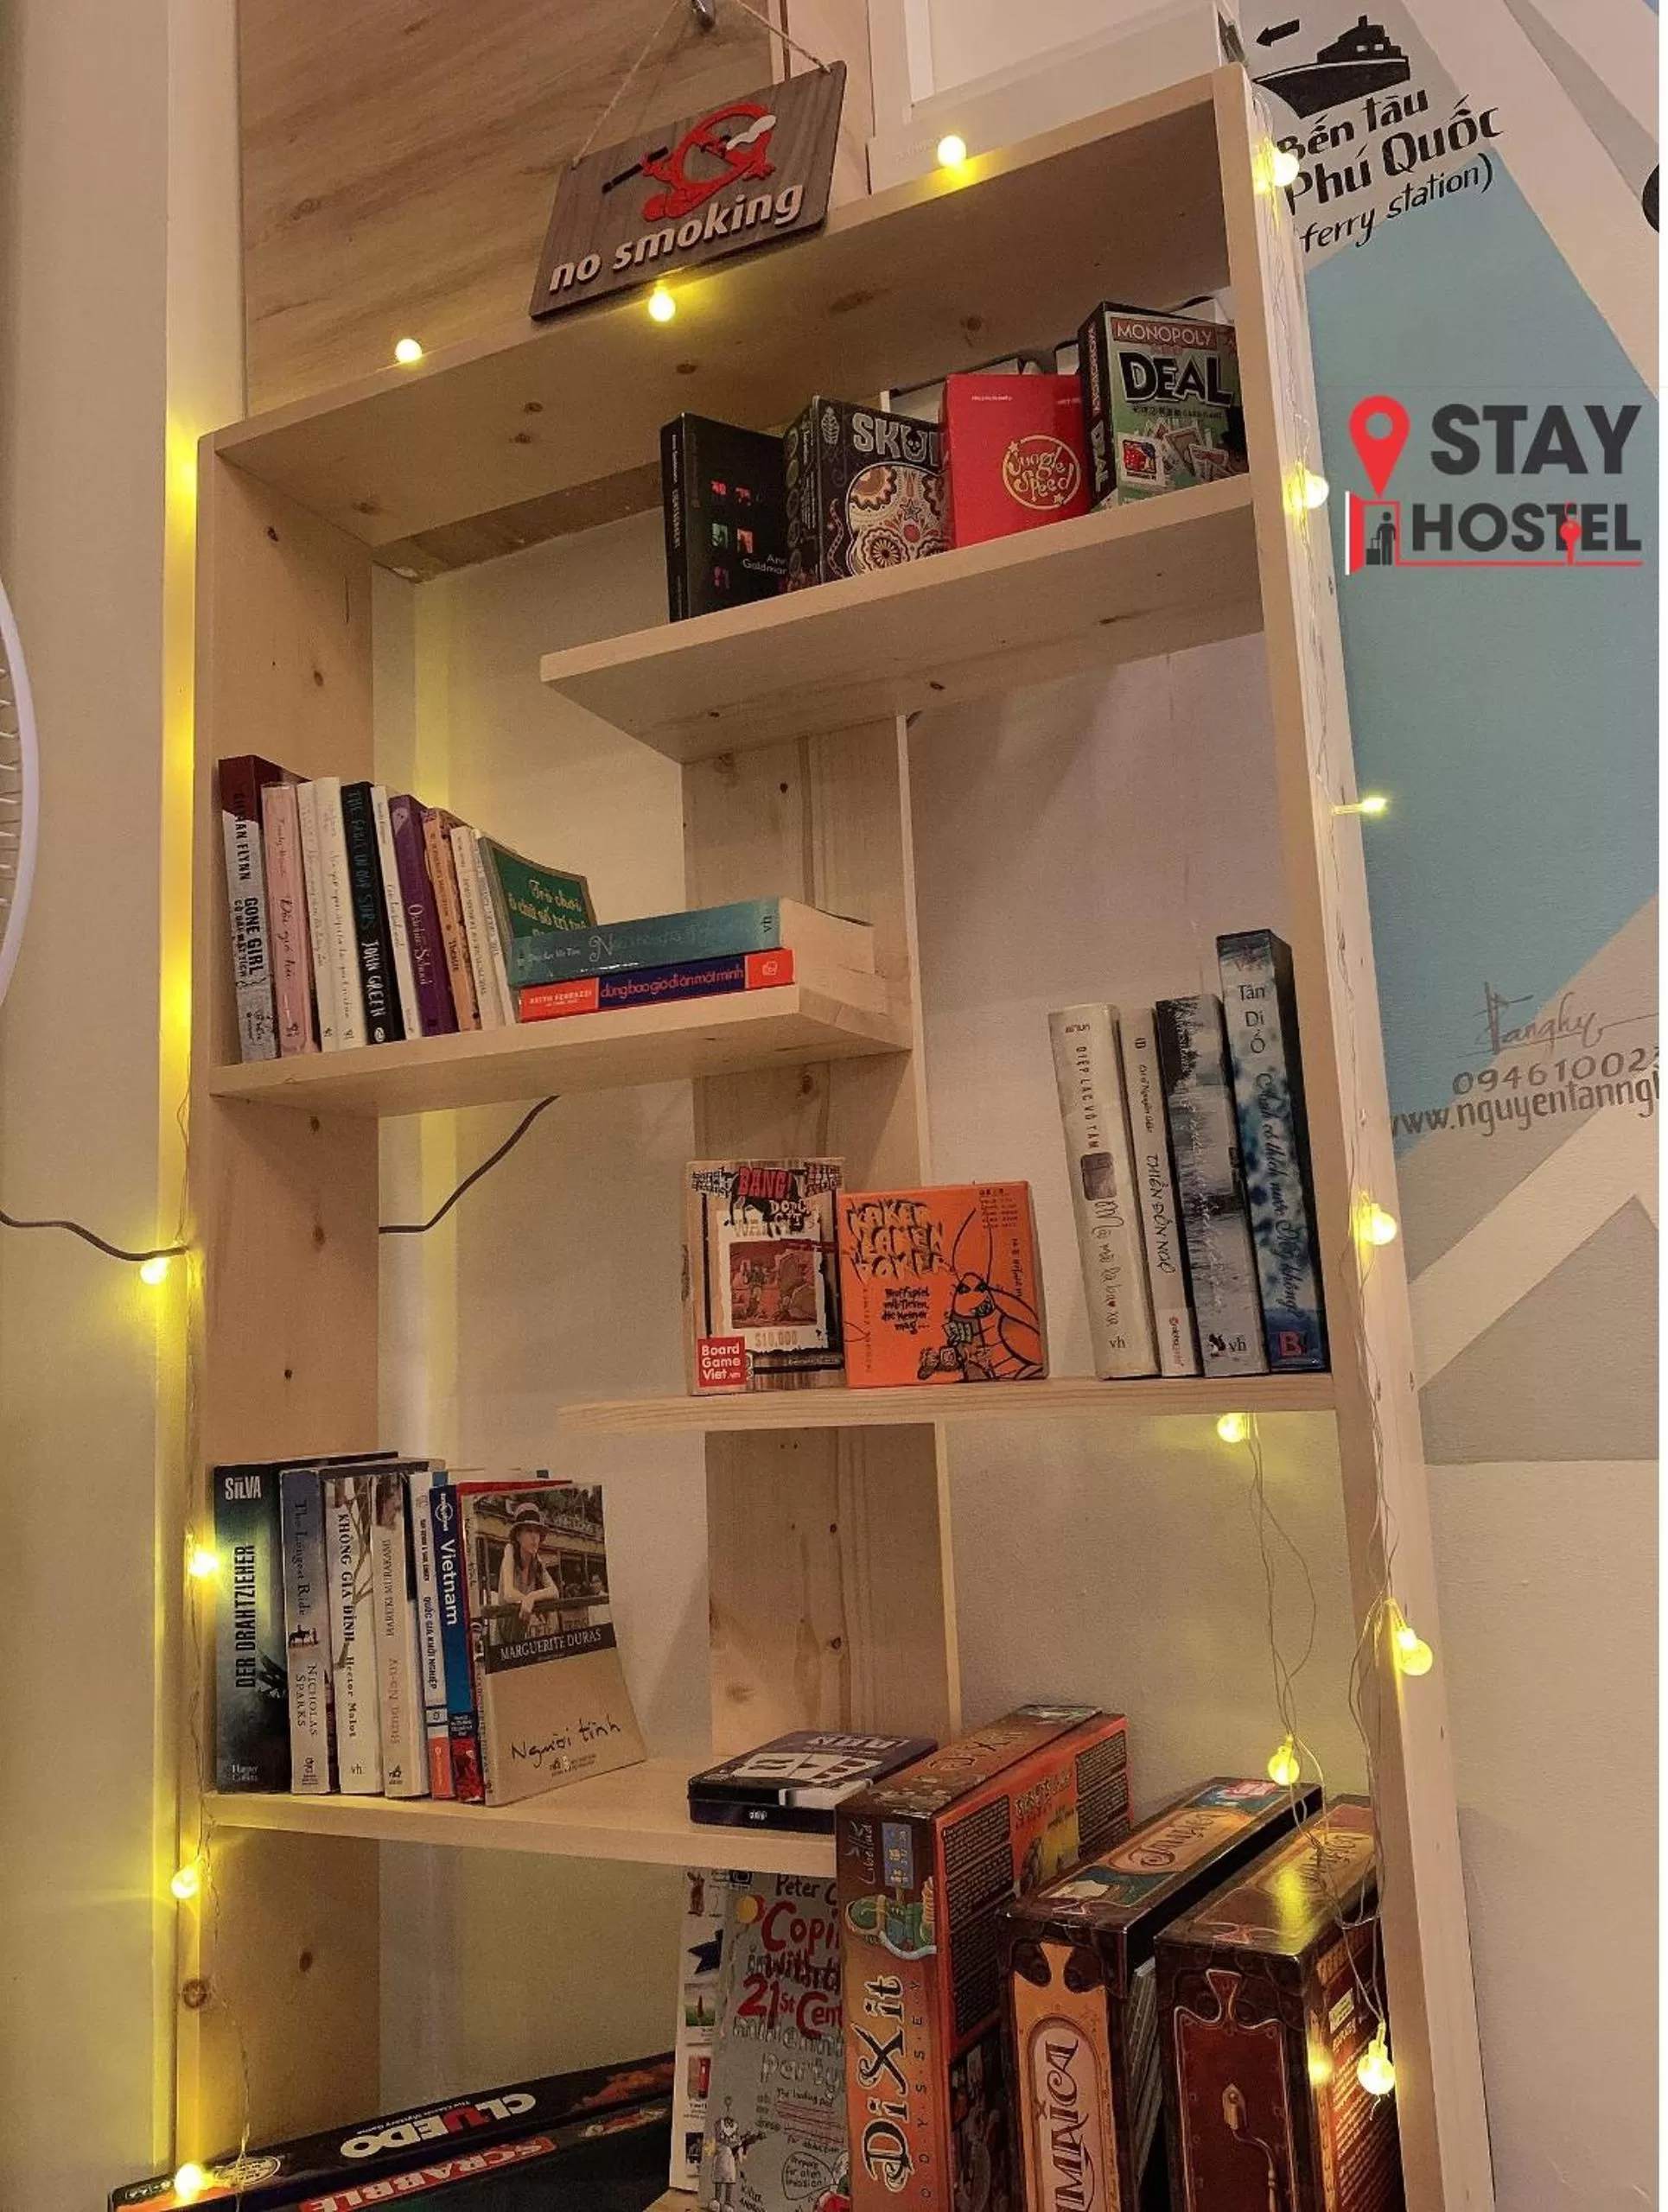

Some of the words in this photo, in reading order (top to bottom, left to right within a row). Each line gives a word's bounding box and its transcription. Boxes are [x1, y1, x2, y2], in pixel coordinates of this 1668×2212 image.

[1381, 93, 1505, 176] Quốc
[1385, 153, 1493, 220] station)
[548, 252, 602, 293] no
[612, 184, 804, 272] smoking
[1117, 321, 1212, 346] MONOPOLY
[1117, 350, 1234, 408] DEAL
[237, 842, 252, 882] FLYNN
[245, 897, 261, 933] GONE
[248, 936, 264, 976] GIRL
[363, 940, 379, 971] JOHN
[366, 974, 385, 1018] GREEN
[1245, 1009, 1265, 1028] Di
[738, 1166, 793, 1198] BANG!
[701, 1342, 741, 1357] Board
[701, 1357, 742, 1369] Game
[294, 1499, 309, 1526] The
[294, 1529, 310, 1580] Longest
[337, 1513, 352, 1566] KHÔNG
[234, 1543, 257, 1652] DRAHTZIEHER
[296, 1582, 313, 1618] Ride
[341, 1569, 354, 1599] GIA
[440, 1538, 458, 1625] Vietnam
[341, 1605, 357, 1643] ĐÌNH
[500, 1636, 566, 1661] MARGUERITE
[566, 1627, 602, 1647] DURAS
[235, 1657, 257, 1689] DER
[347, 1655, 357, 1698] Hector
[295, 1675, 308, 1728] SPARKS
[306, 1664, 319, 1737] NICHOLAS
[348, 1700, 359, 1738] Malot
[775, 1874, 821, 1898] Peter
[850, 1974, 915, 2193] DiXit
[339, 2092, 538, 2159] CLUEDO
[308, 2137, 550, 2212] SCRABBLE
